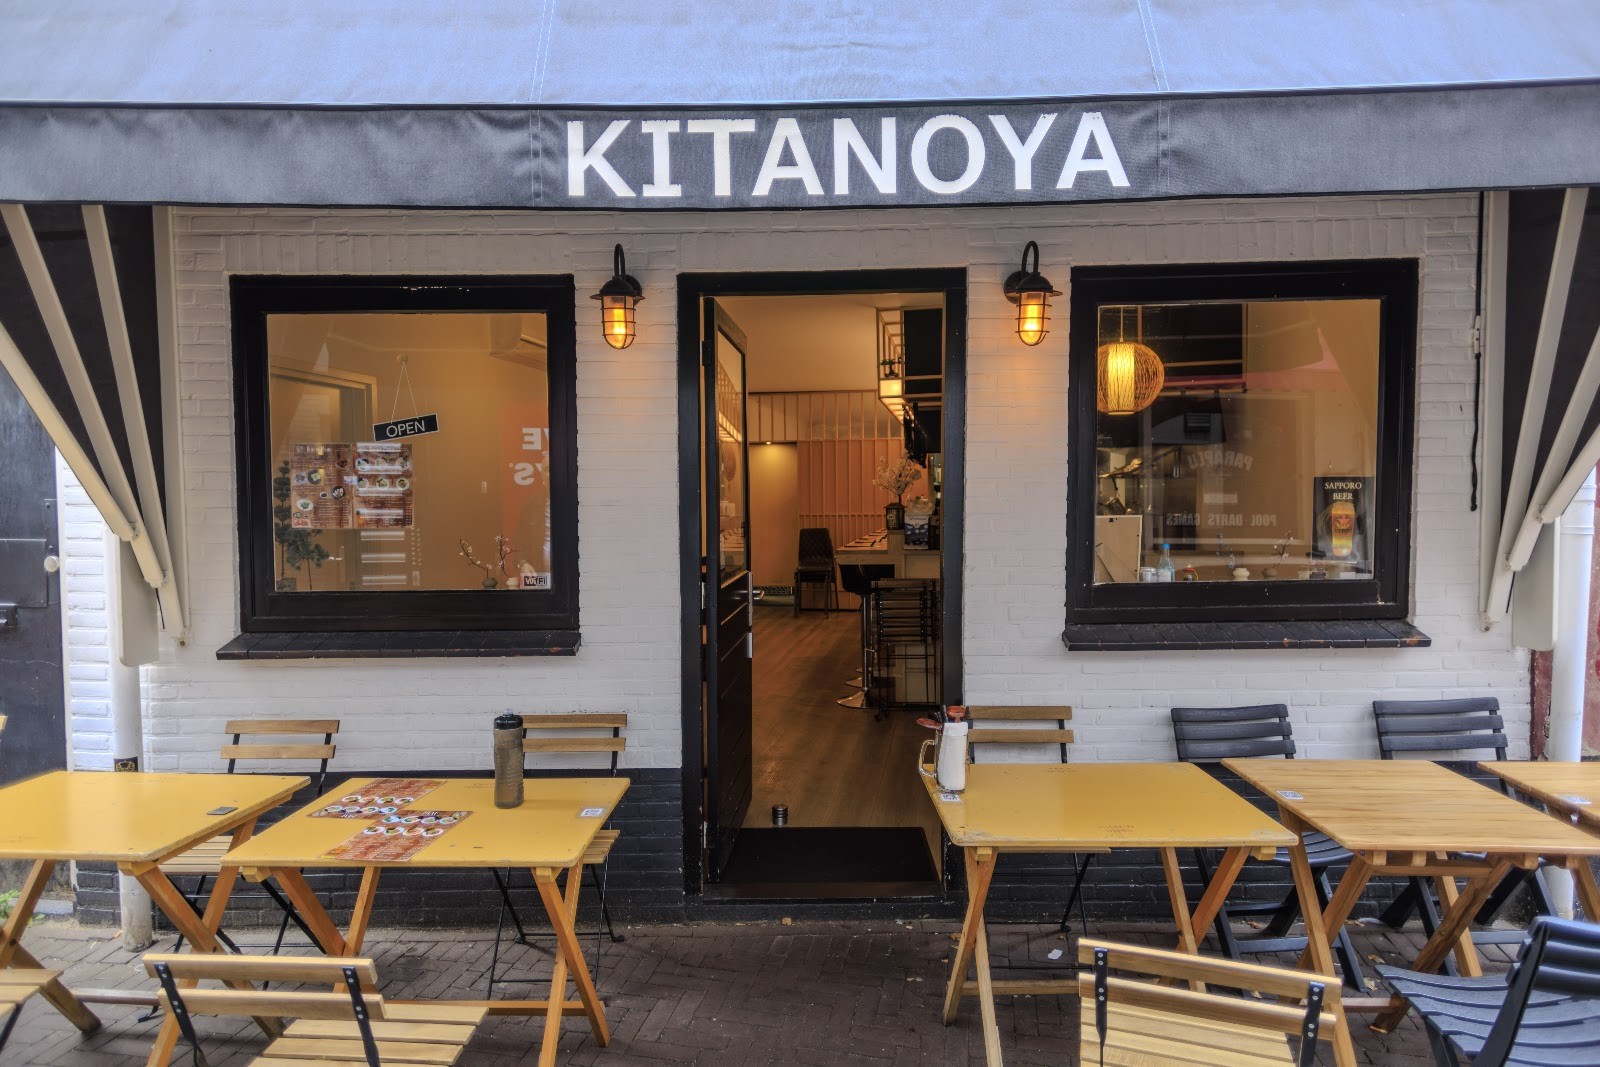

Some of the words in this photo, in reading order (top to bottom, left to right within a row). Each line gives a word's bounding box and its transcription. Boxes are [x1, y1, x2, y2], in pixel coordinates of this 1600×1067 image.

[567, 112, 1130, 196] KITANOYA
[386, 419, 426, 437] OPEN
[1324, 481, 1363, 490] SAPPORO
[1333, 492, 1354, 500] BEER
